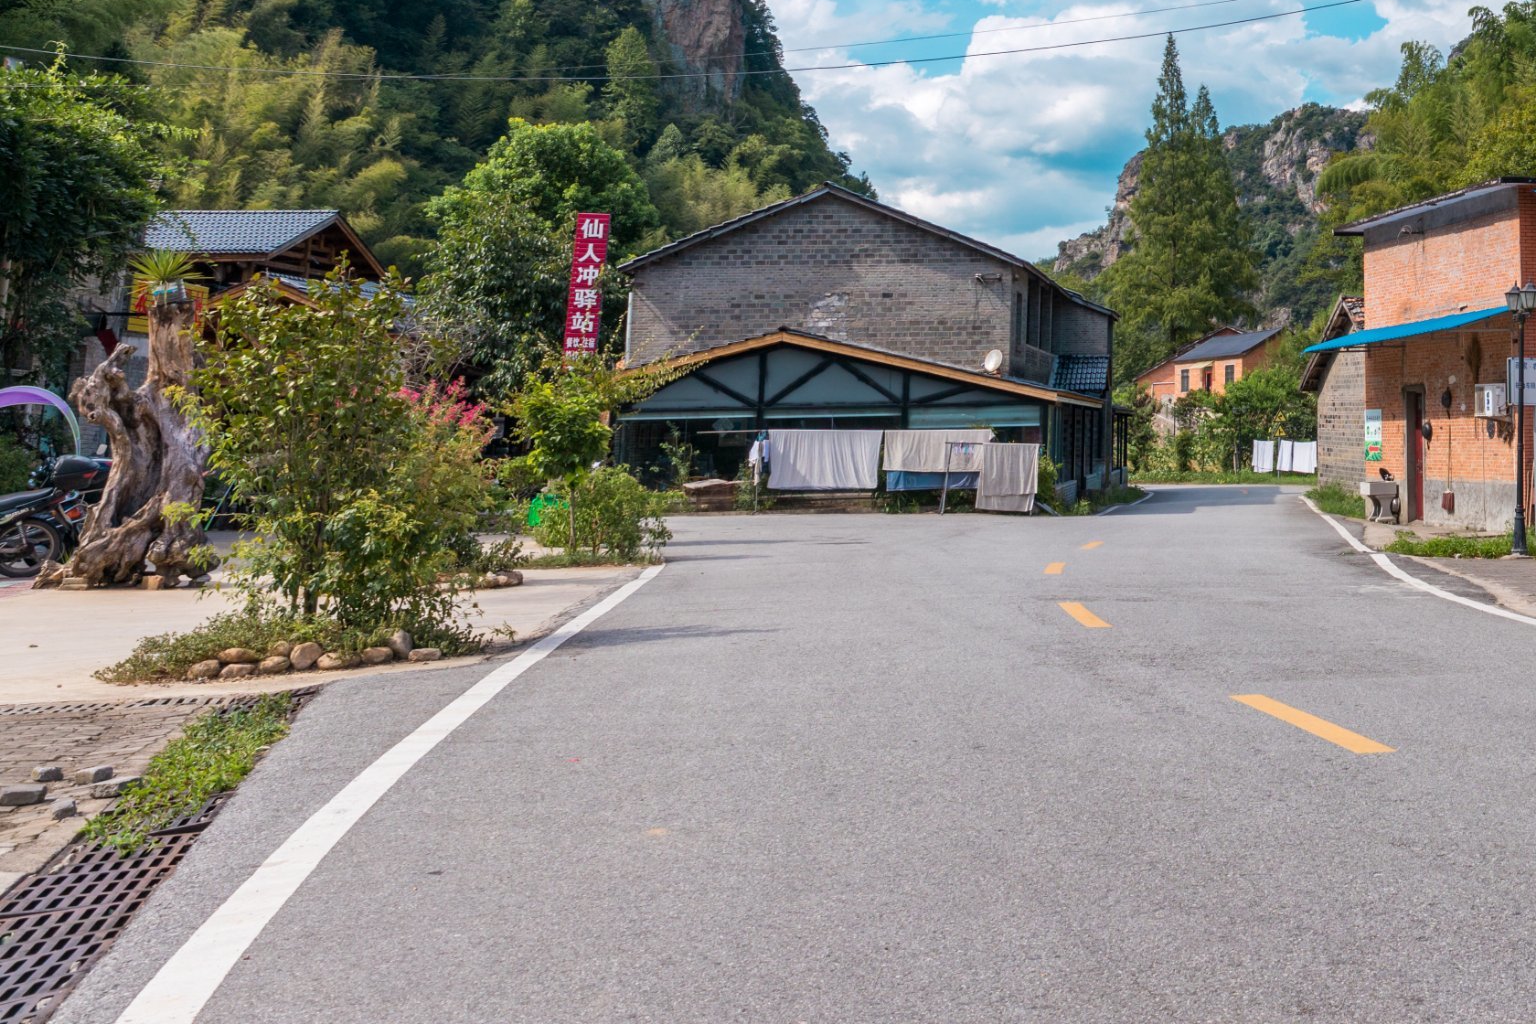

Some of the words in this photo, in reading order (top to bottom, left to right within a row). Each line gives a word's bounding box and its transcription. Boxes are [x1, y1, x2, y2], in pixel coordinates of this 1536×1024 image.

[570, 218, 604, 334] 仙人冲驿站
